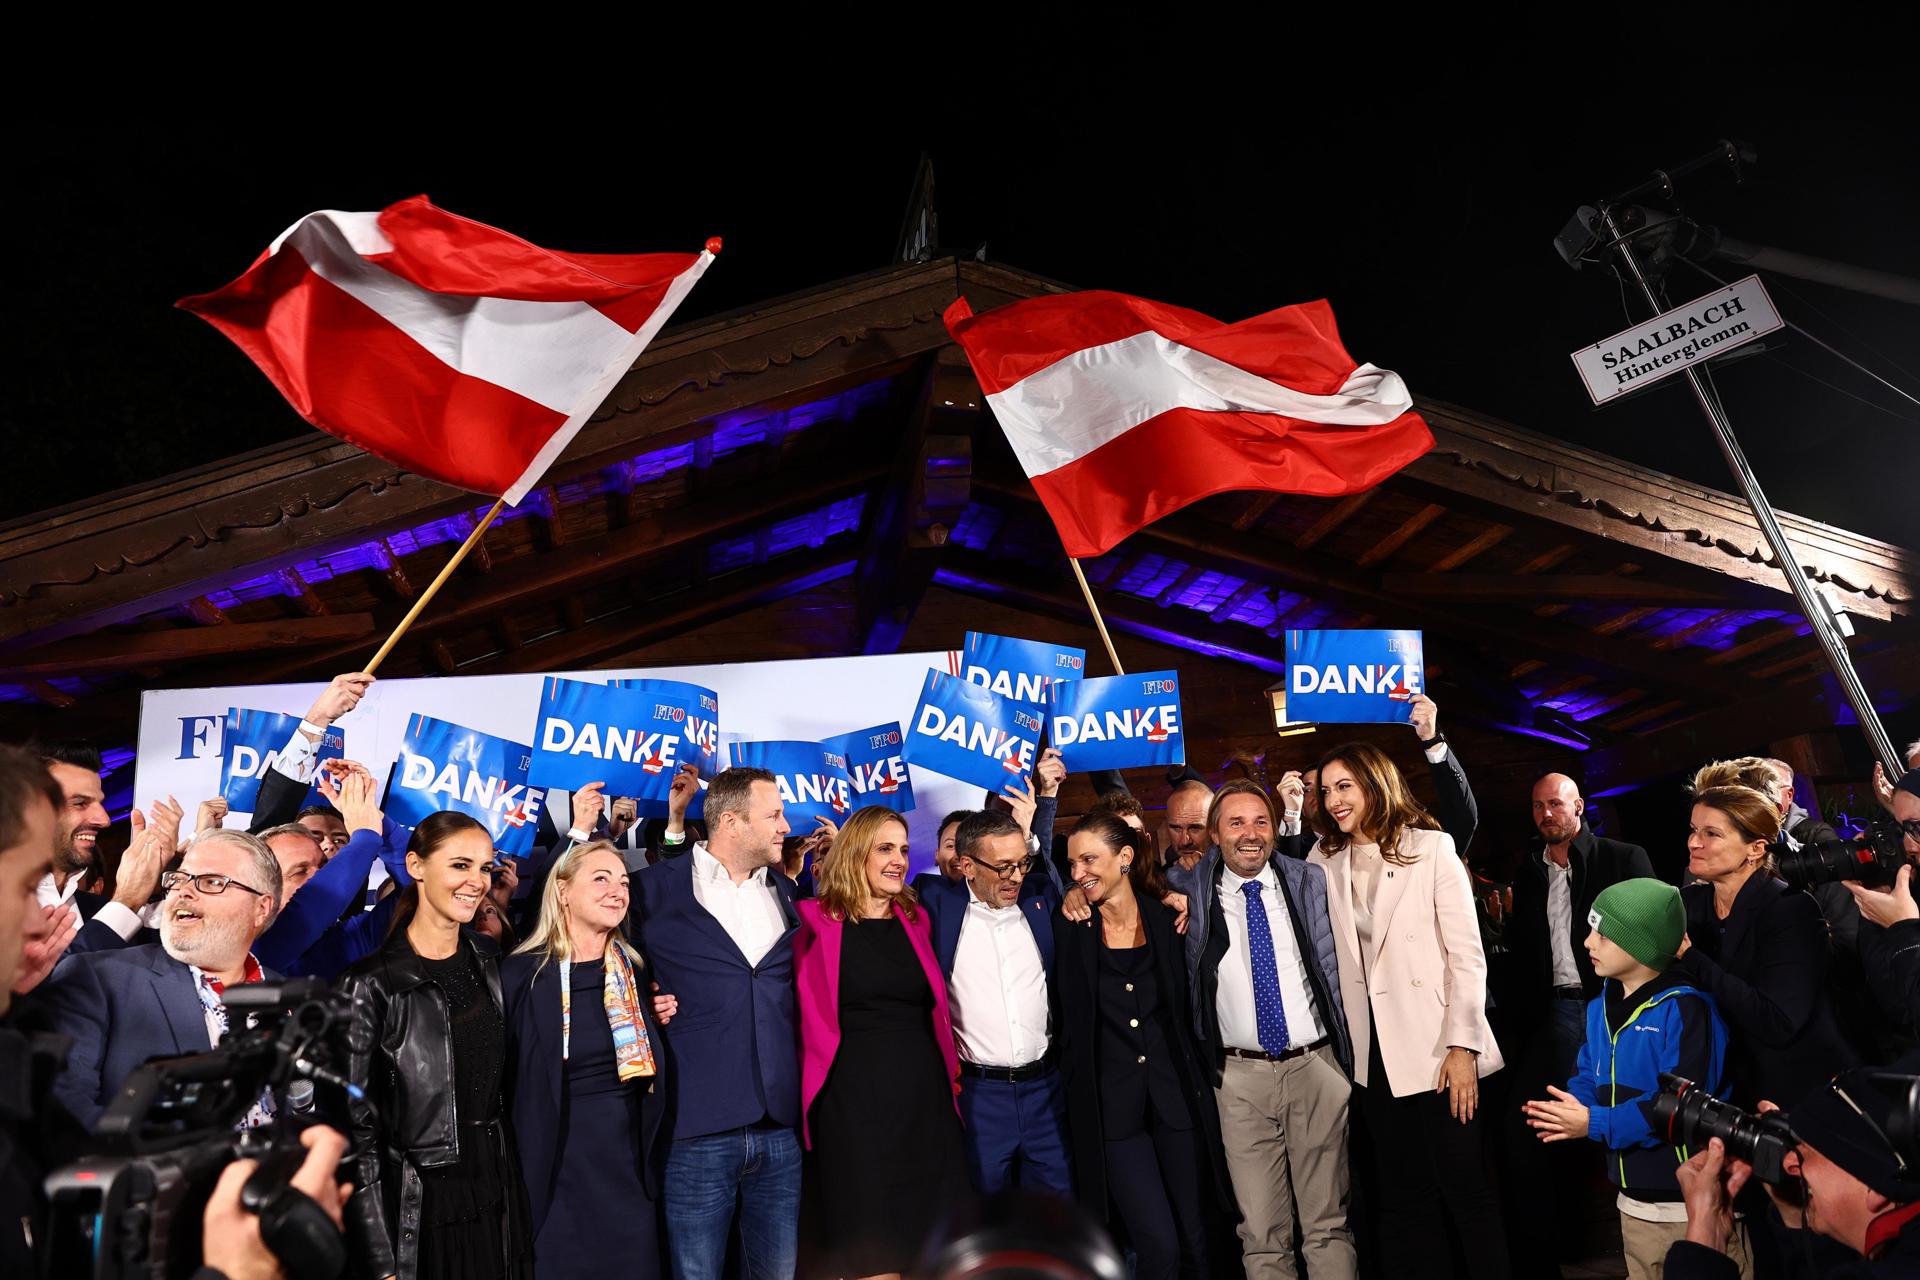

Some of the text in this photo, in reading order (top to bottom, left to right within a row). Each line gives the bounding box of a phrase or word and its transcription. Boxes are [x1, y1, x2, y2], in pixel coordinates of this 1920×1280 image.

[1602, 297, 1745, 369] SAALBACH
[1614, 320, 1751, 384] Hinterglemm
[965, 665, 1071, 704] DAN
[1293, 665, 1421, 694] DANKE
[175, 715, 228, 760] F
[542, 717, 679, 767] DANKE
[916, 704, 1035, 771] DANKE
[1053, 705, 1178, 746] DANKE
[401, 754, 544, 823] DANKE
[776, 773, 850, 809] ANKE
[847, 755, 907, 793] NKE
